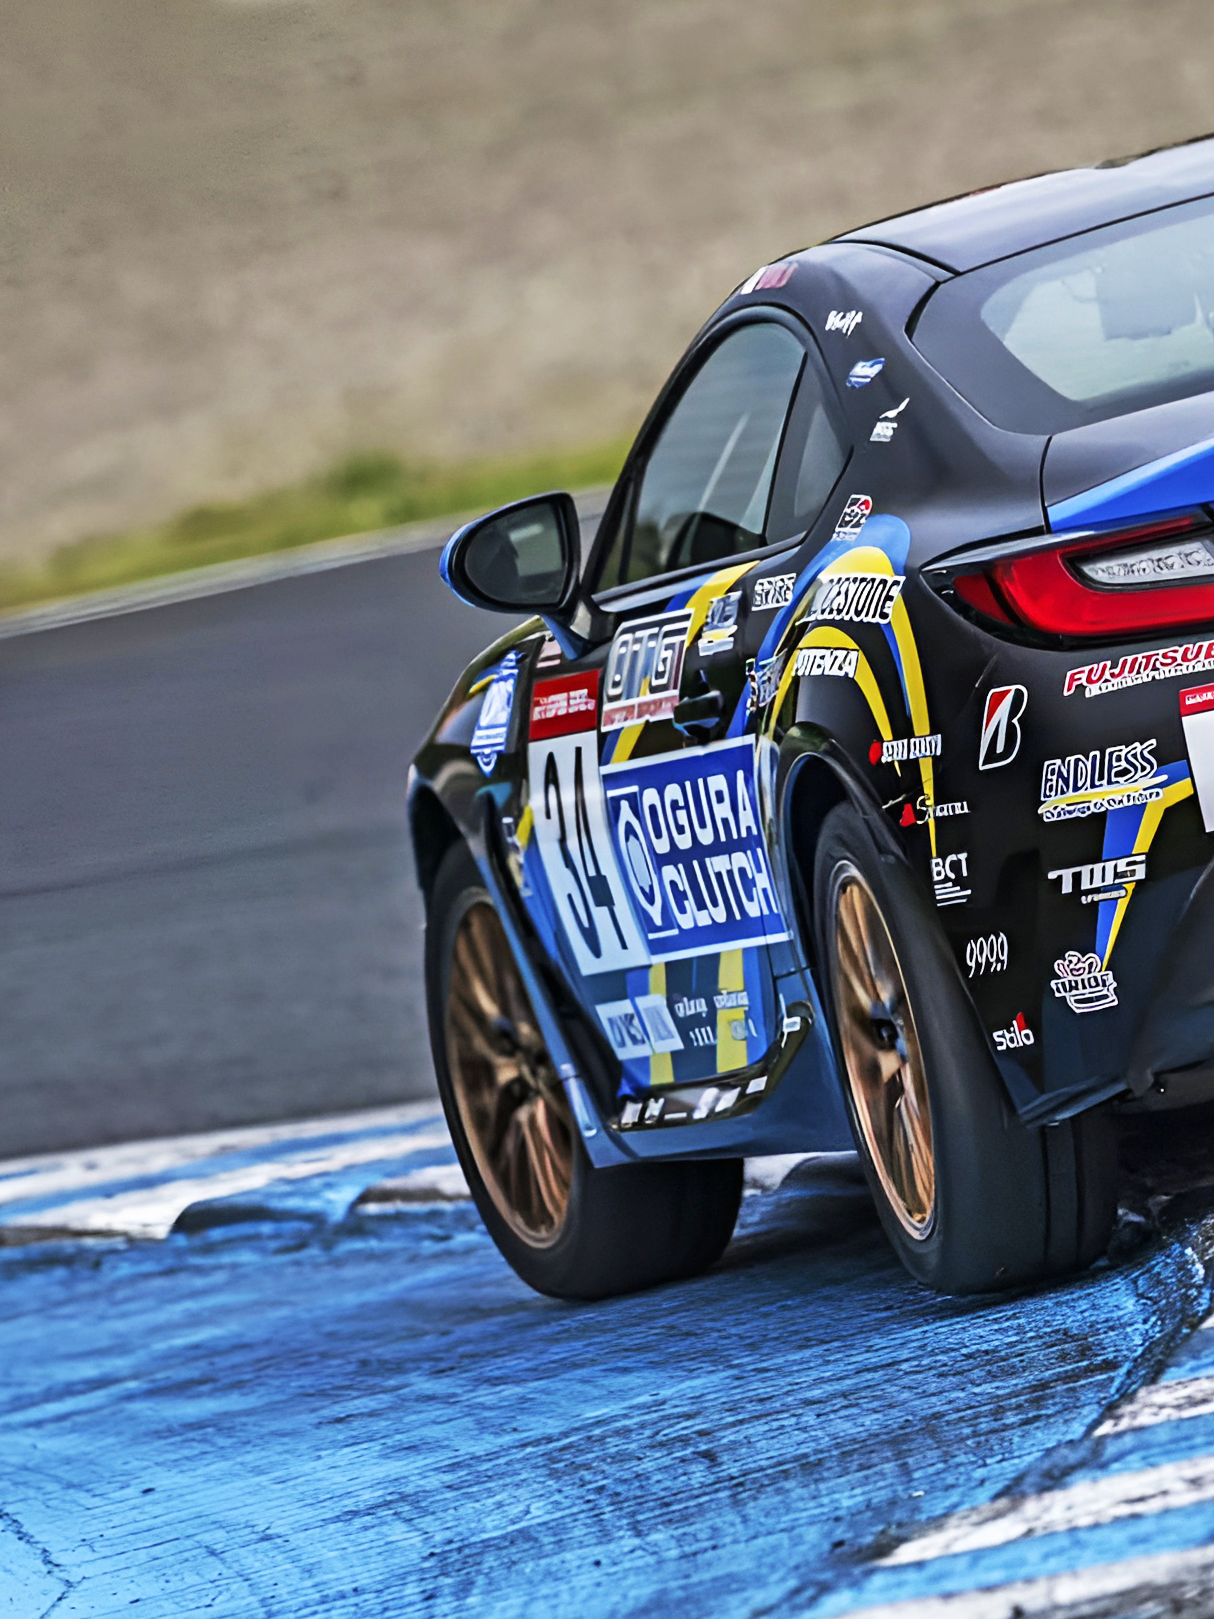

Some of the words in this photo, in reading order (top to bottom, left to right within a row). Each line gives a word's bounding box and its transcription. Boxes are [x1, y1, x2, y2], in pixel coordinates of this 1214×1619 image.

[642, 769, 758, 854] OGURA
[1041, 738, 1158, 802] ENDLESS
[543, 745, 629, 960] 34
[661, 847, 779, 930] CLUTCH
[1047, 854, 1147, 894] TWS
